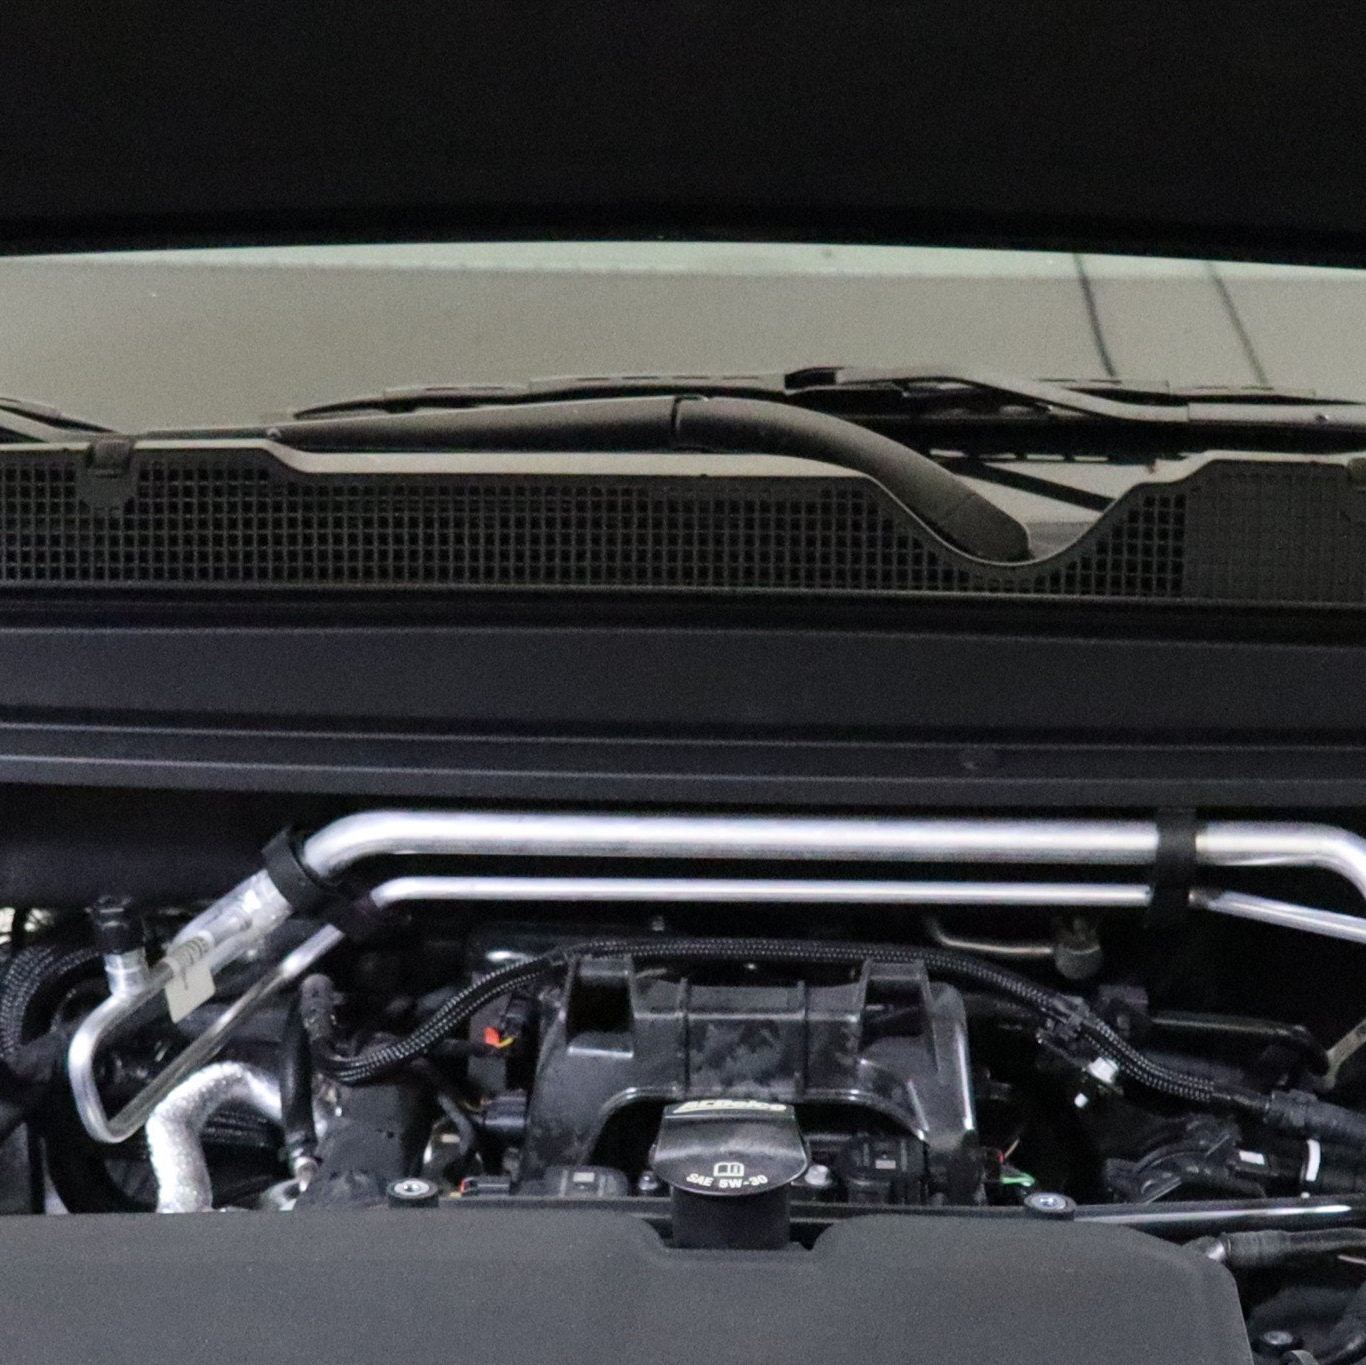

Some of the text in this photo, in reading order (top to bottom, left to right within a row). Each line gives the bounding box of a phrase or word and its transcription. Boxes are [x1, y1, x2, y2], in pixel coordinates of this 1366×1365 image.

[672, 1099, 787, 1114] ACDelco
[686, 1173, 769, 1188] SAE 5W-30
